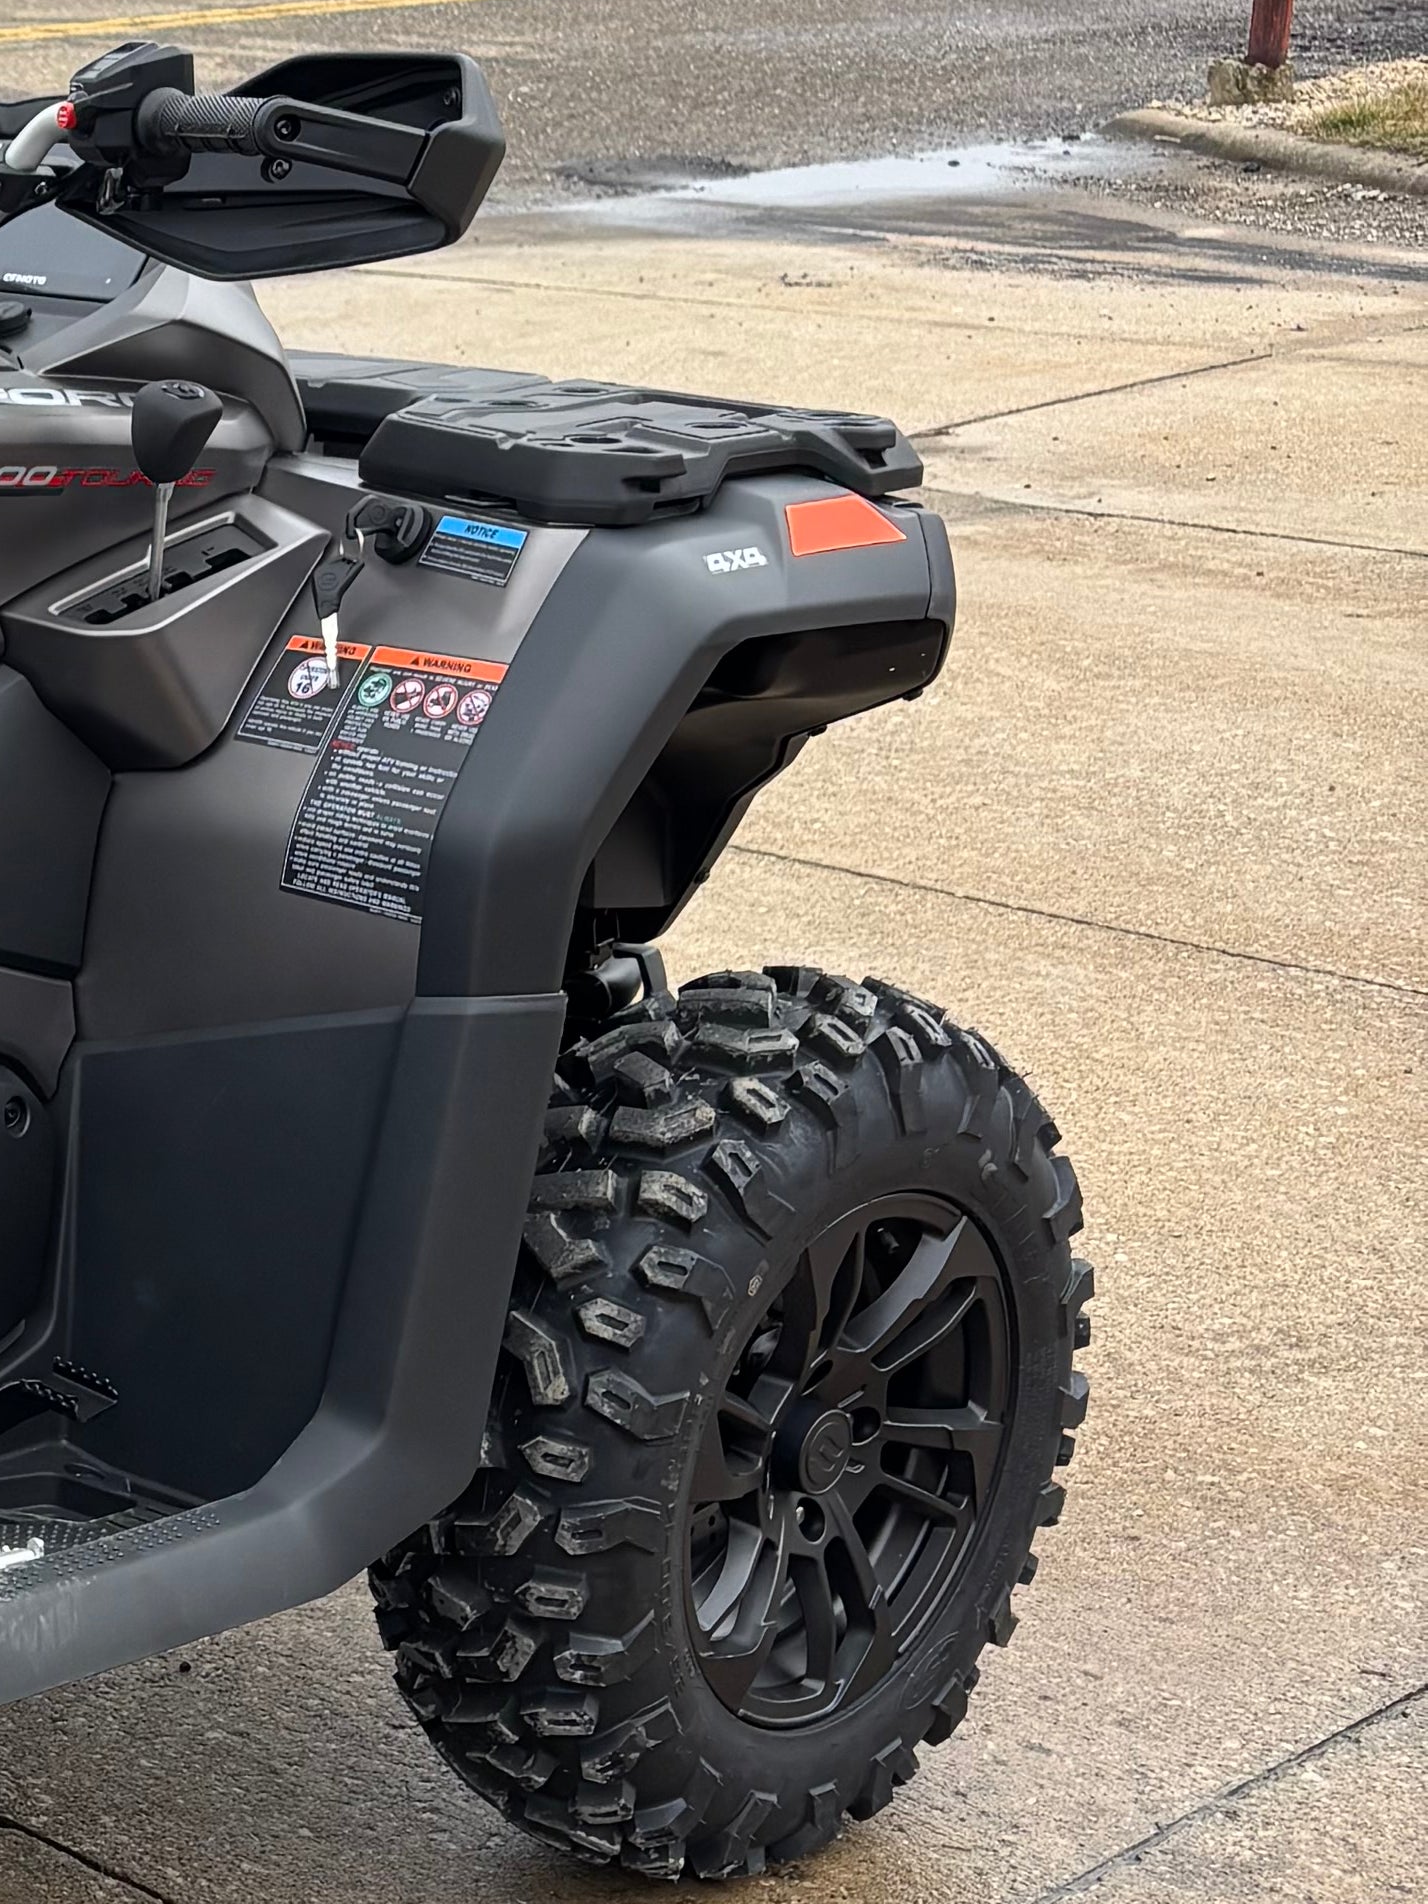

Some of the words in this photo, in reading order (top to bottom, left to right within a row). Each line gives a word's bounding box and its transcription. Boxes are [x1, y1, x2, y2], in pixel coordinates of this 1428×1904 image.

[62, 467, 217, 488] TOURG
[464, 524, 500, 539] NOTICE
[422, 658, 473, 674] WARNING
[295, 681, 311, 695] 16
